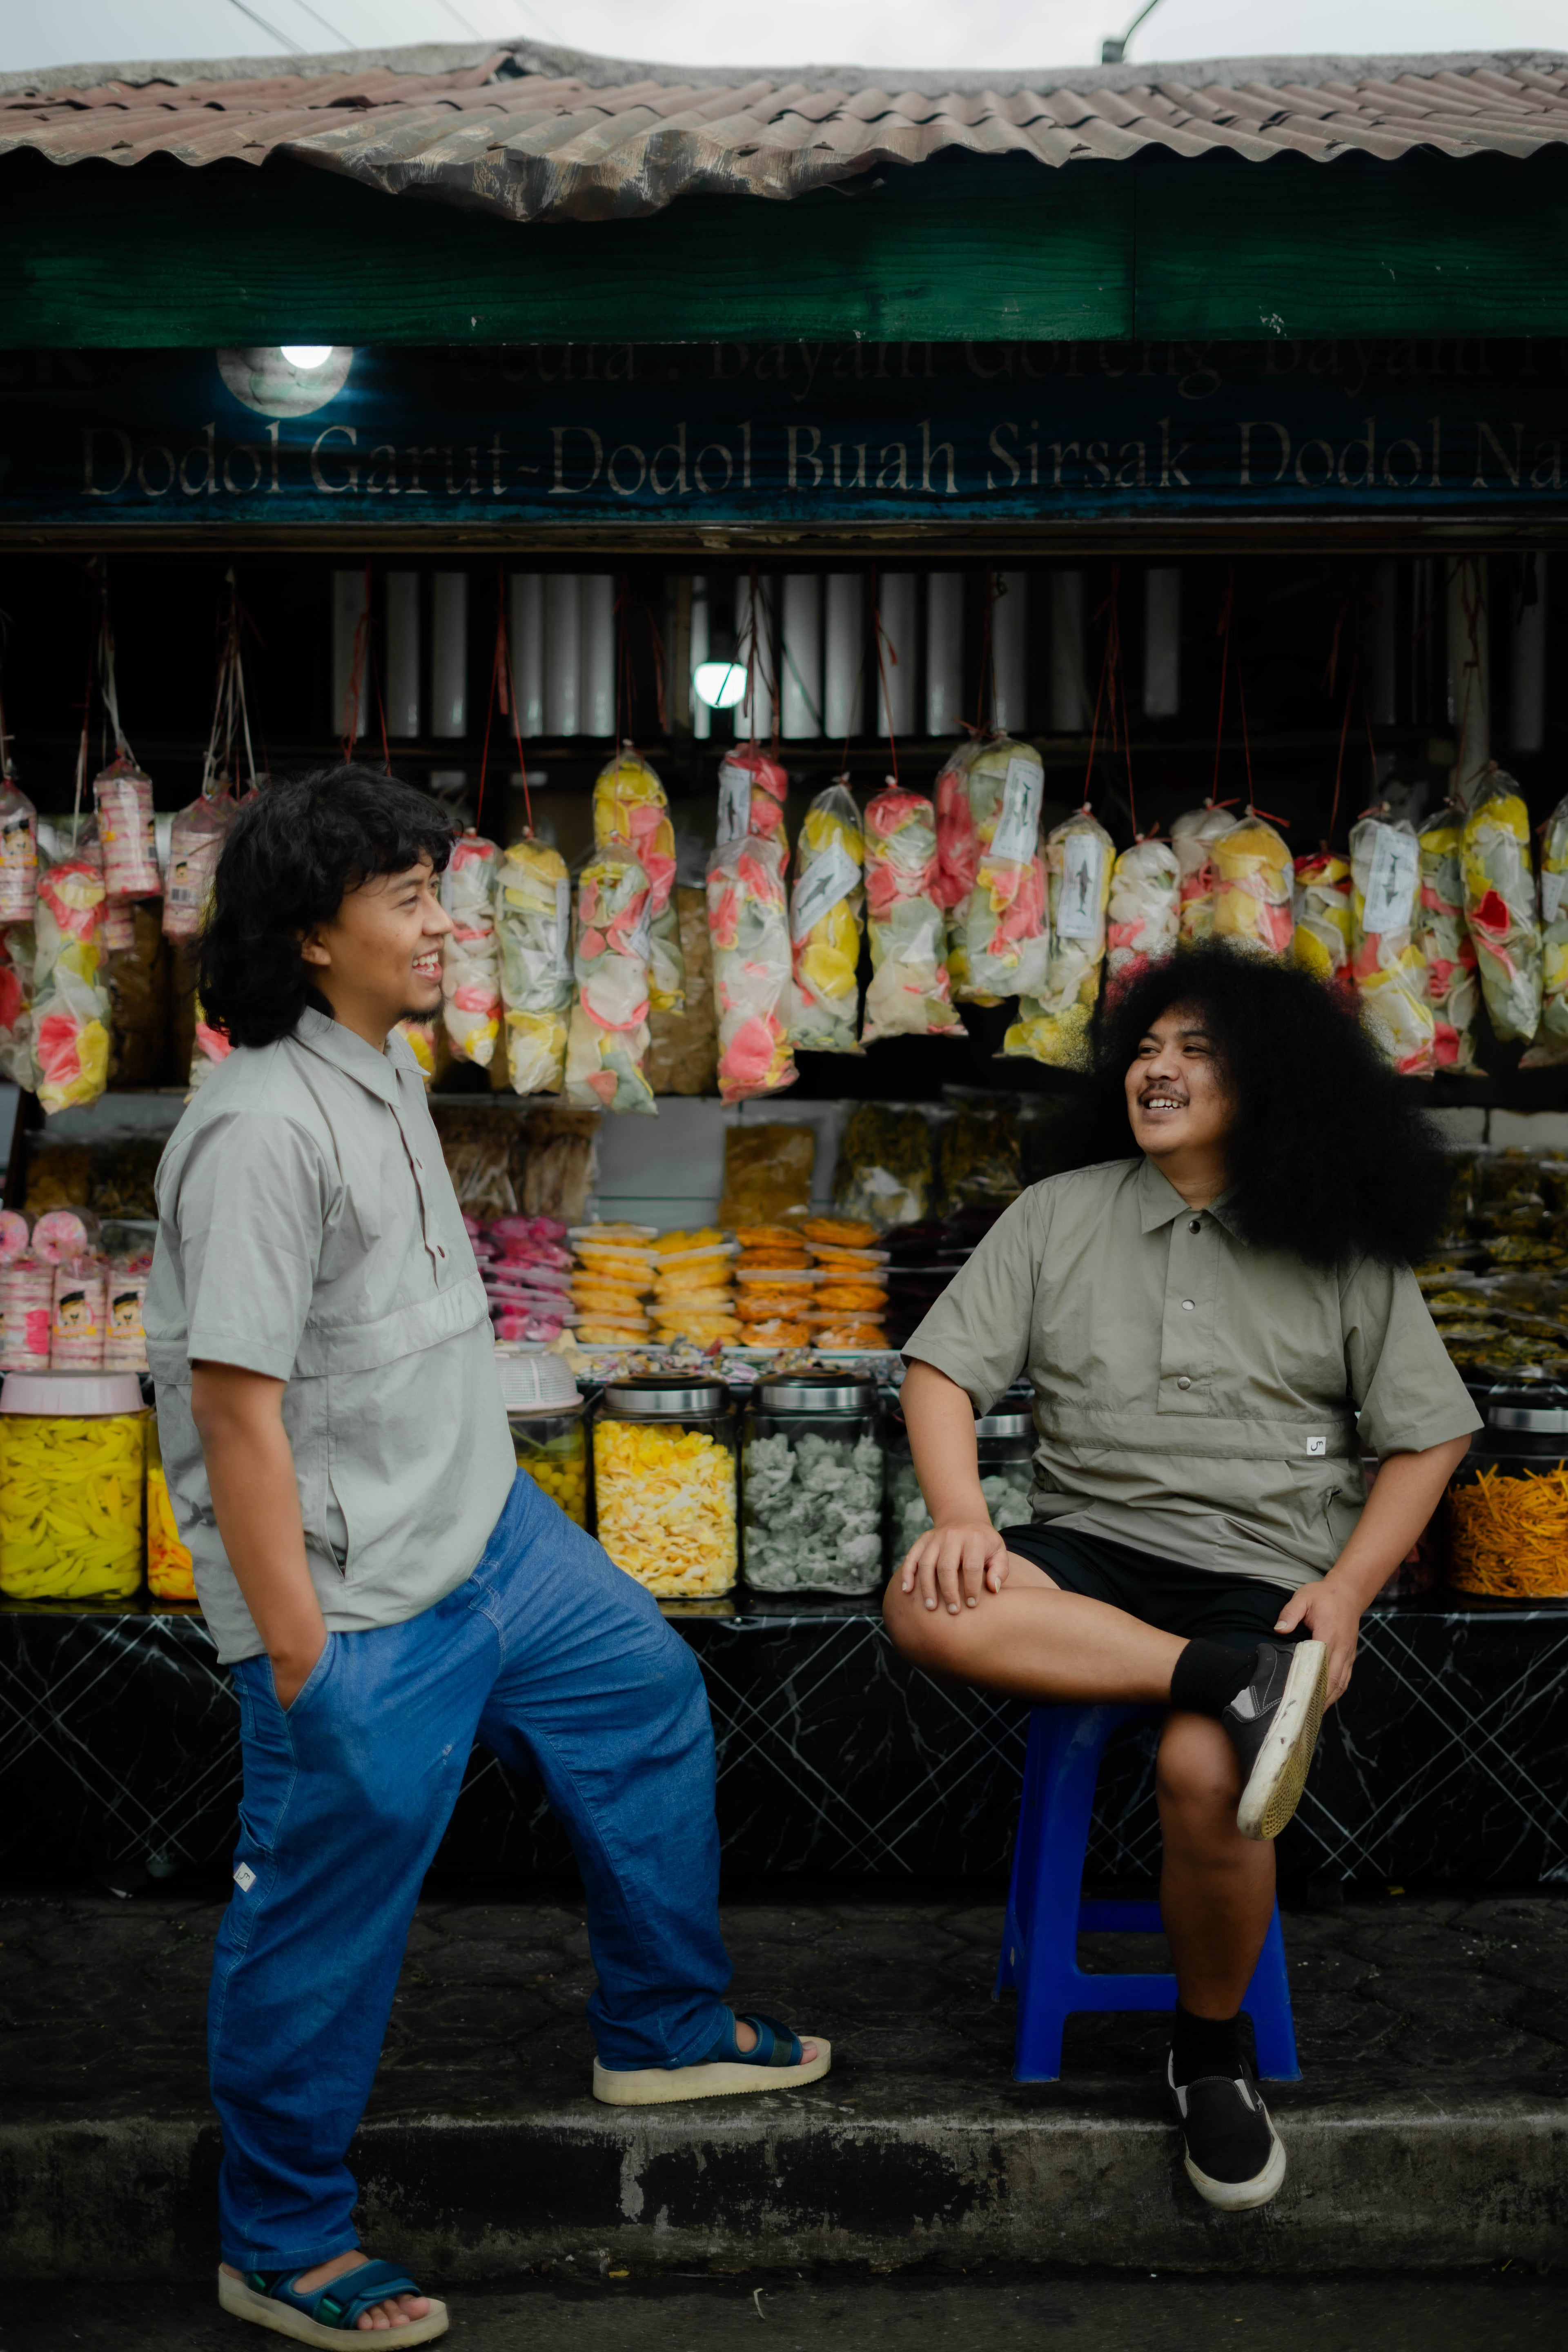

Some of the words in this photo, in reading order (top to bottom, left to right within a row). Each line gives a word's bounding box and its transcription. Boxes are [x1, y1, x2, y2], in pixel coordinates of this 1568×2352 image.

[79, 420, 285, 497] Dodol
[782, 417, 960, 493] Buah
[986, 416, 1197, 490] Sirsak
[1235, 414, 1443, 489] Dodol
